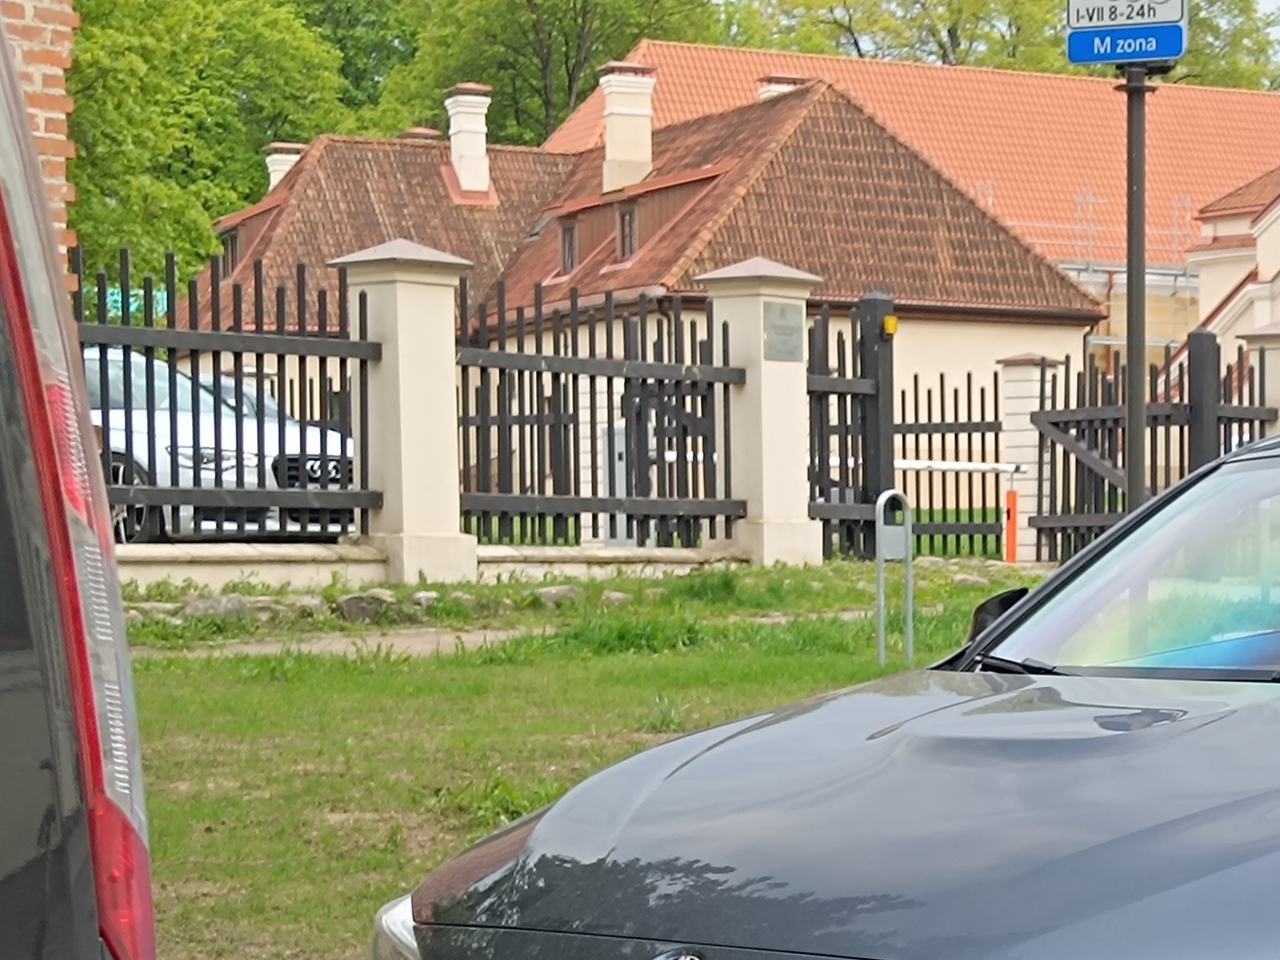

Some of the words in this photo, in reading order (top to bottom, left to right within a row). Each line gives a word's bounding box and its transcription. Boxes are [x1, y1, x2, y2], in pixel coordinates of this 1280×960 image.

[1076, 7, 1104, 23] I-VII
[1094, 37, 1111, 54] M
[1116, 37, 1156, 53] zona
